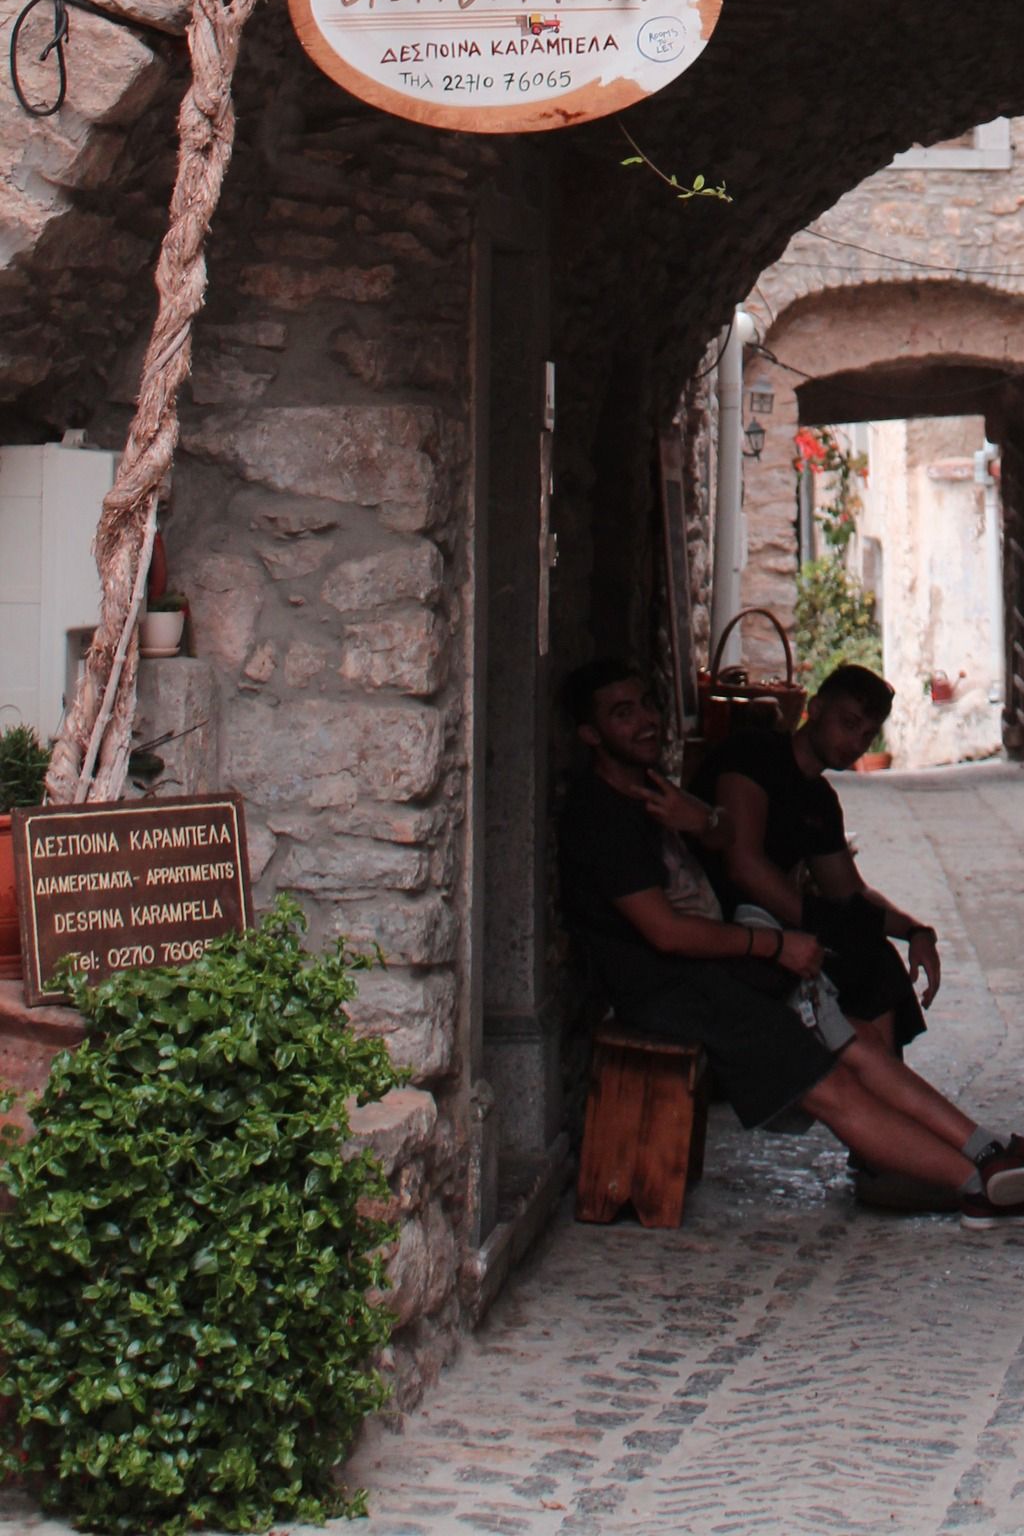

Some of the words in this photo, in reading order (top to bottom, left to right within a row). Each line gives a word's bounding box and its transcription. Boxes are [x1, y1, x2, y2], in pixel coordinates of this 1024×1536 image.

[380, 38, 482, 64] ΔΕΣΠΟΙΝΑ
[491, 34, 619, 56] ΚΑΡΑΜΠΕΛΑ
[442, 74, 494, 92] 22710
[503, 70, 572, 92] 76065
[34, 832, 119, 858] ΔΕΣΠΟΙΝΑ
[129, 824, 231, 851] ΚΑΡΑΜΠΕΛΑ
[146, 862, 235, 886] APPARTMENTS
[54, 908, 124, 934] DESPINA
[131, 899, 223, 927] KARAMPELA
[107, 946, 155, 968] 02710
